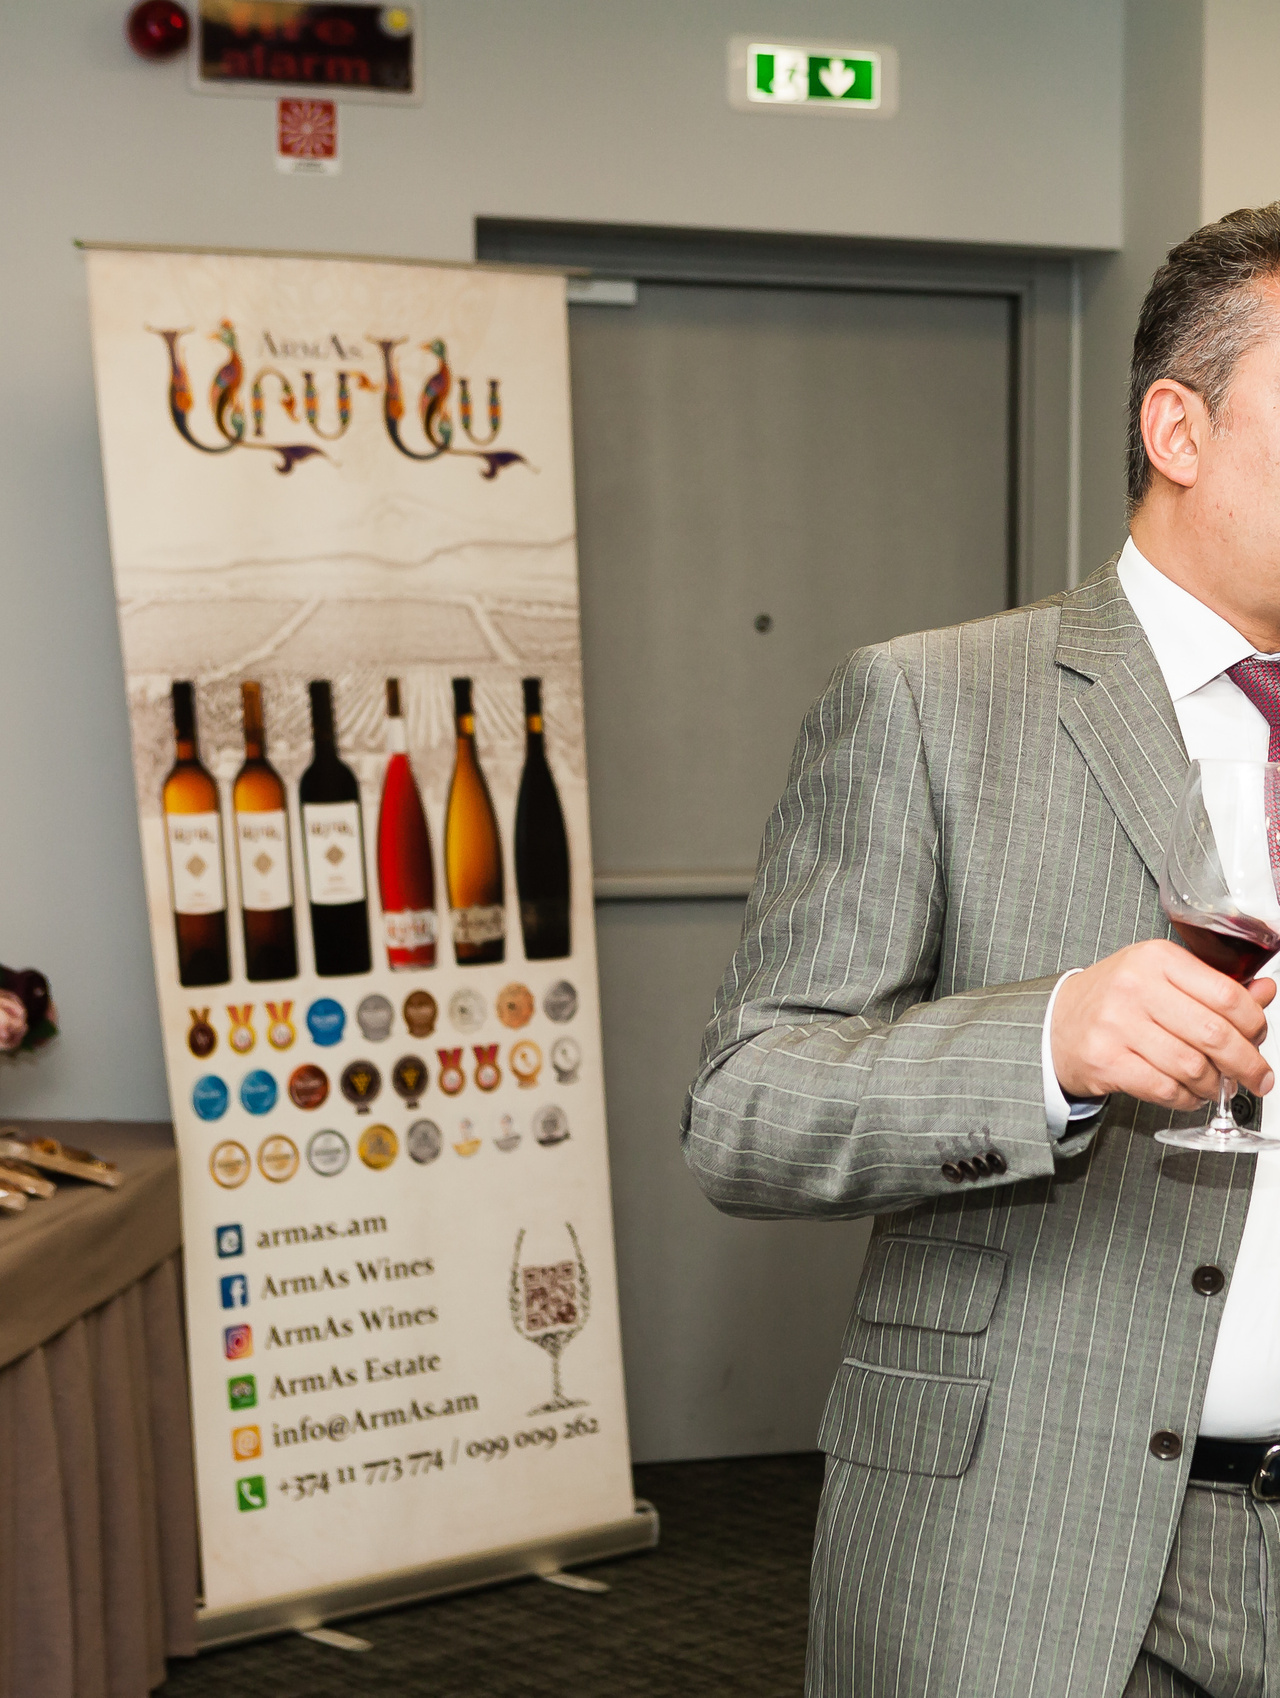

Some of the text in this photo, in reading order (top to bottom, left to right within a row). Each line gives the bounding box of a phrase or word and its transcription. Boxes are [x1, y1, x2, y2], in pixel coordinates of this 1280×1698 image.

[222, 44, 371, 84] alarm
[256, 1215, 389, 1249] armas.am
[260, 1256, 436, 1300] ArmAs Wines
[264, 1304, 440, 1351] ArmAs Wines
[268, 1352, 442, 1400] ArmAs Estate
[271, 1393, 480, 1449] info@ArmAs.am
[278, 1471, 331, 1501] +374
[362, 1458, 402, 1486] 773
[408, 1448, 445, 1477] 774
[465, 1434, 510, 1463] 099
[513, 1424, 558, 1450] 009
[562, 1413, 600, 1440] 262
